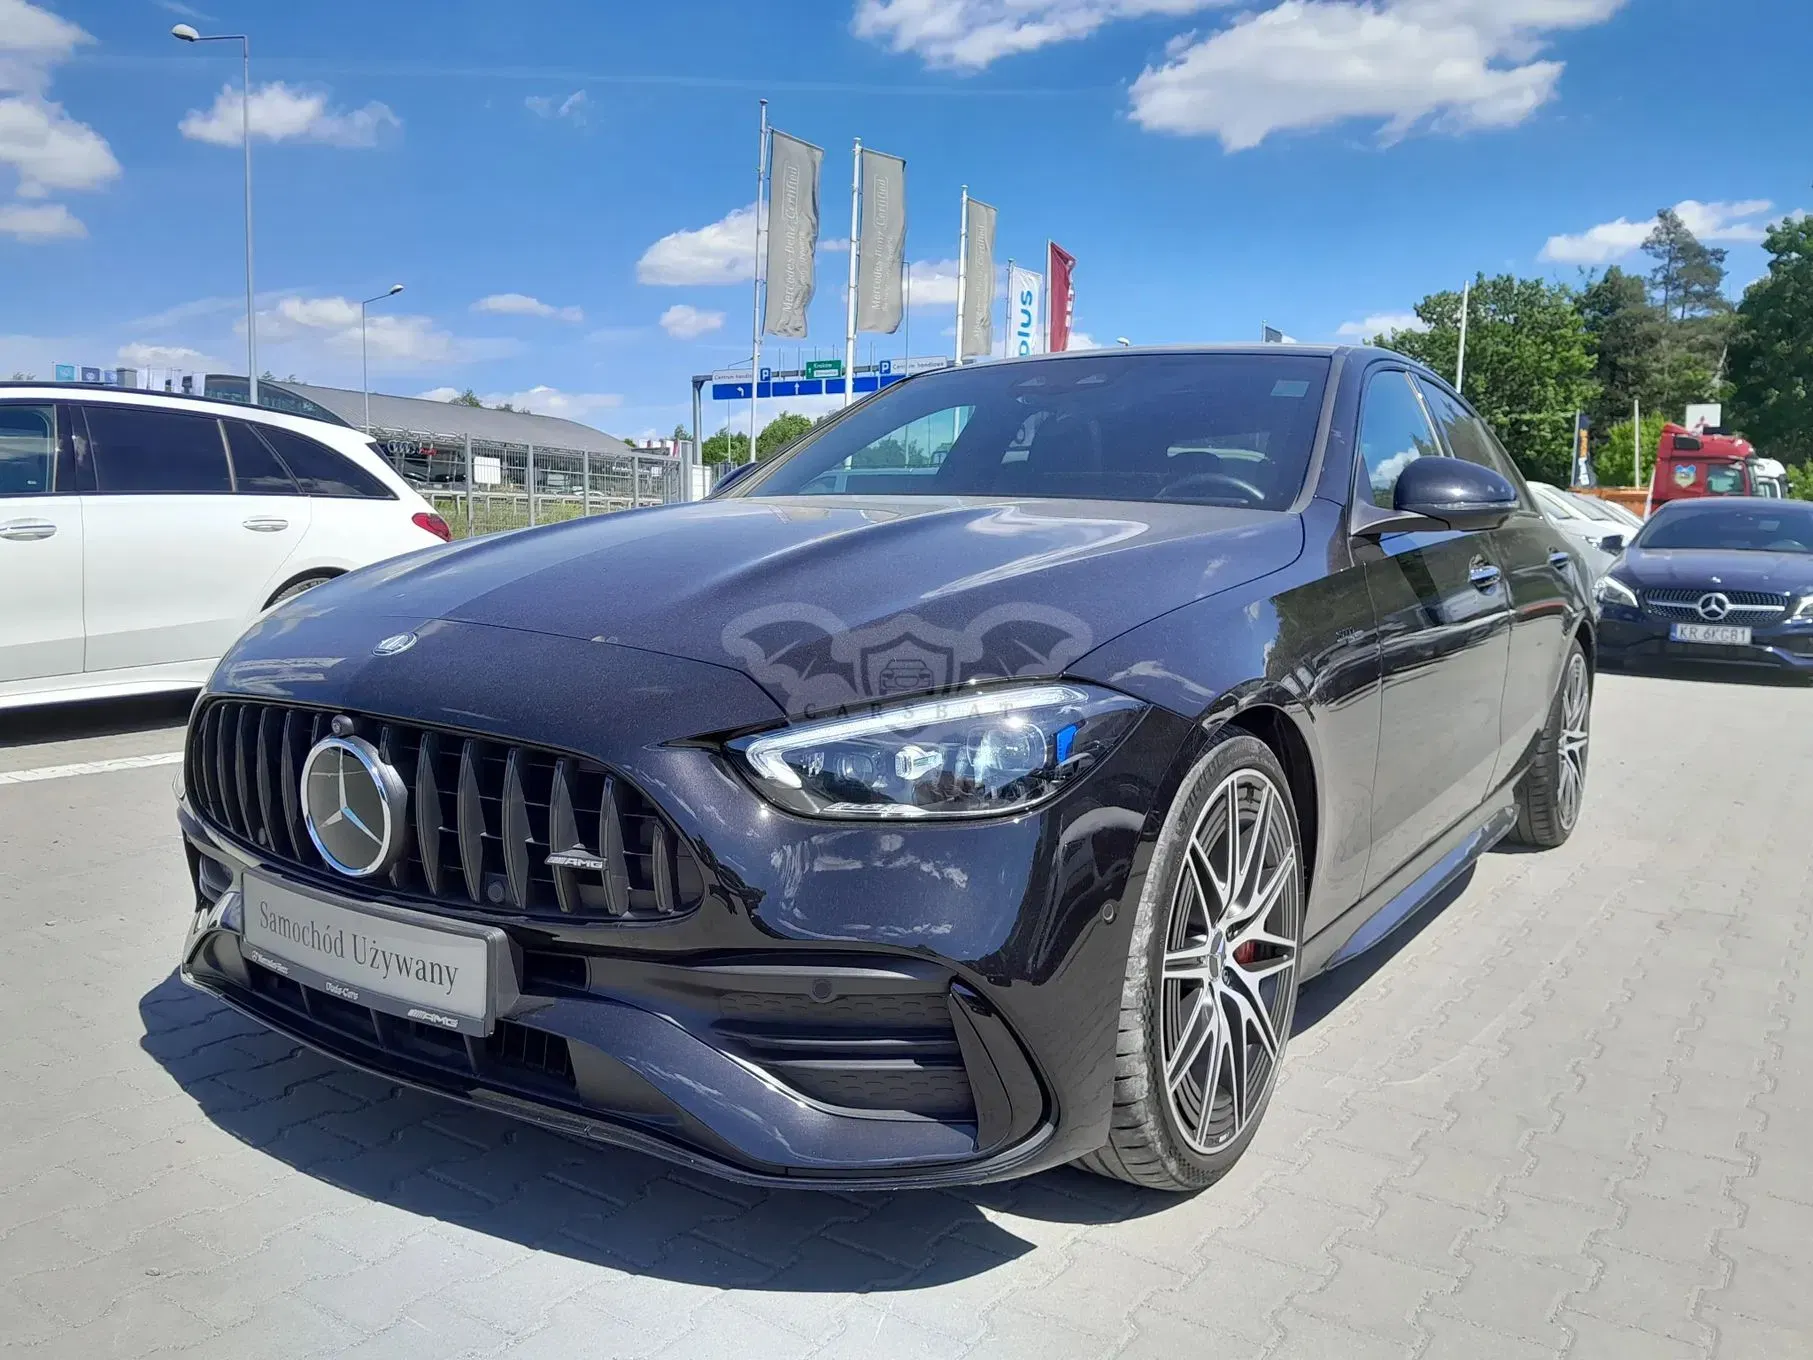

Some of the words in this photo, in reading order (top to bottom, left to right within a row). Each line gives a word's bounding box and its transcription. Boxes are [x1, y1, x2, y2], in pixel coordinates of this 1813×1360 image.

[564, 858, 603, 869] AMG
[259, 901, 345, 960] Samochód
[352, 933, 460, 996] Używany
[422, 1011, 459, 1028] AMG
